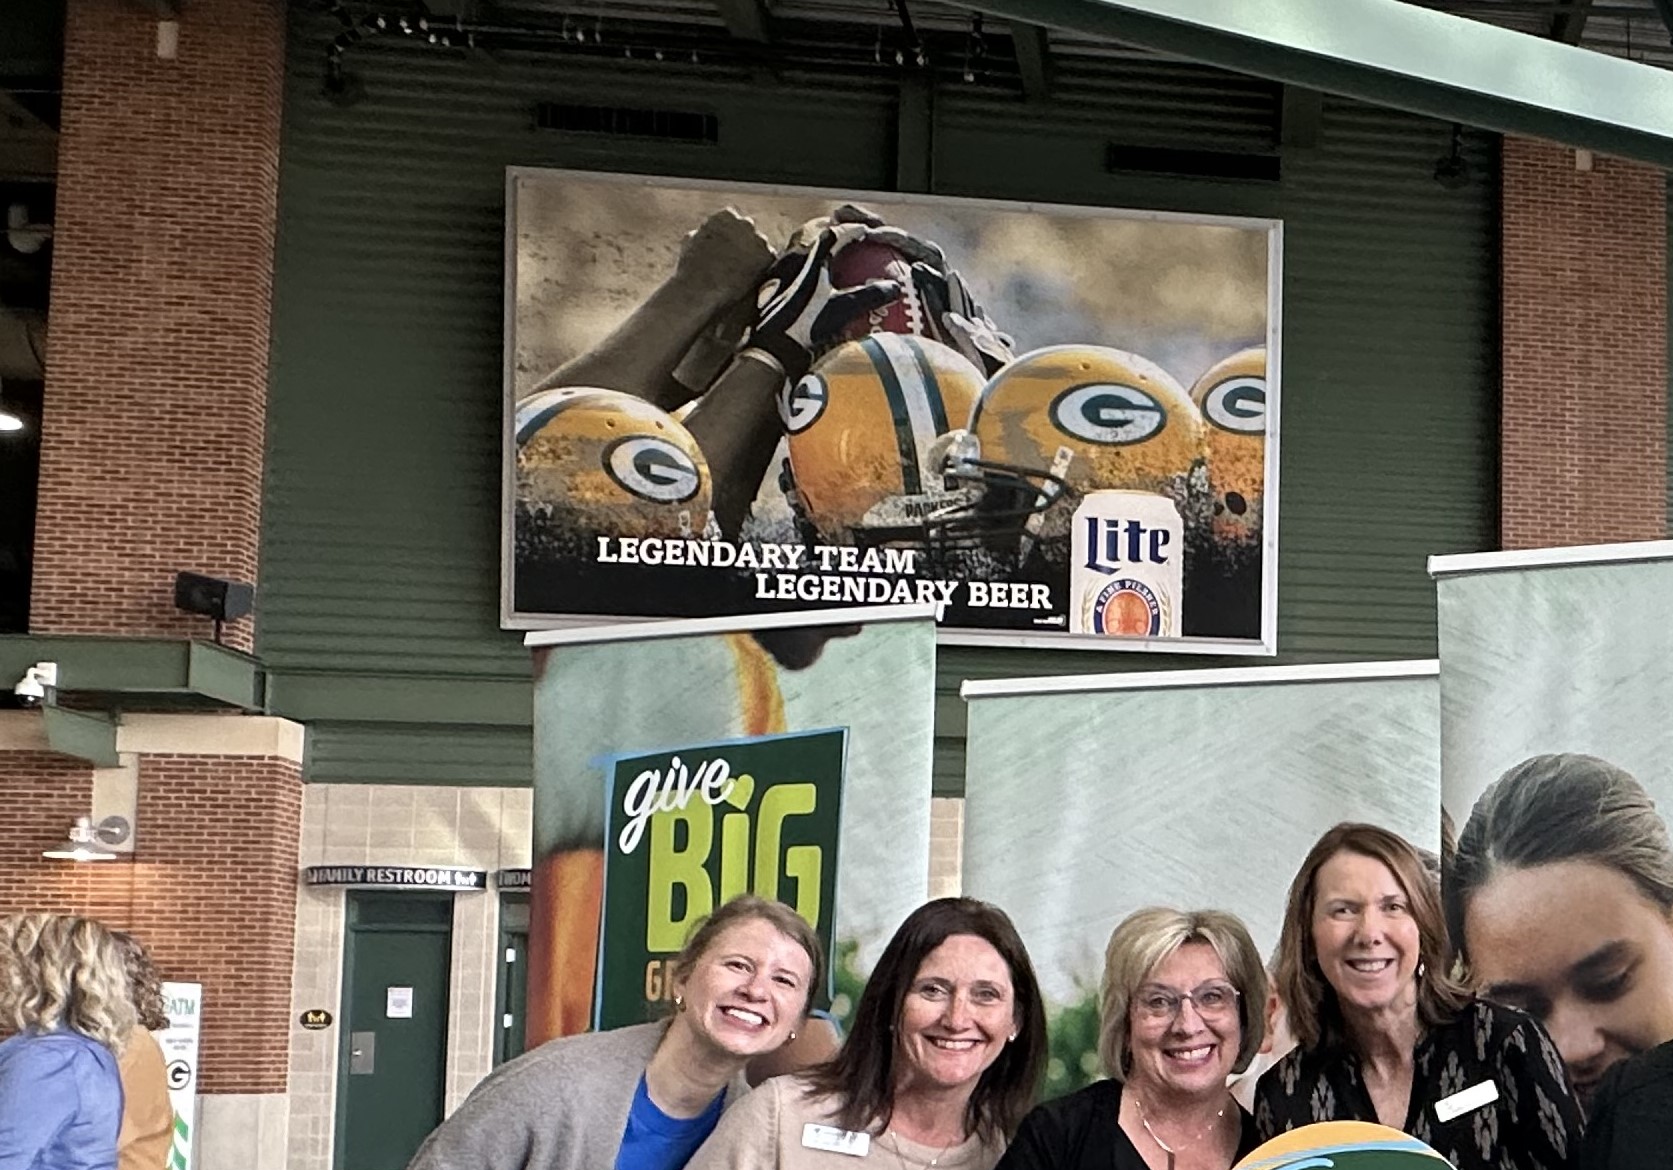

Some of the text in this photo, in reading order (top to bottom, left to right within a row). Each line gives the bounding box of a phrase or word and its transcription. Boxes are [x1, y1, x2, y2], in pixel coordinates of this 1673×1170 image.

[597, 536, 916, 574] LEGENDARY TEAM
[1084, 516, 1170, 576] Lite
[755, 574, 1053, 610] LEGENDARY BEER
[618, 756, 735, 855] give
[366, 869, 450, 884] RESTROOM
[504, 871, 531, 885] WOM
